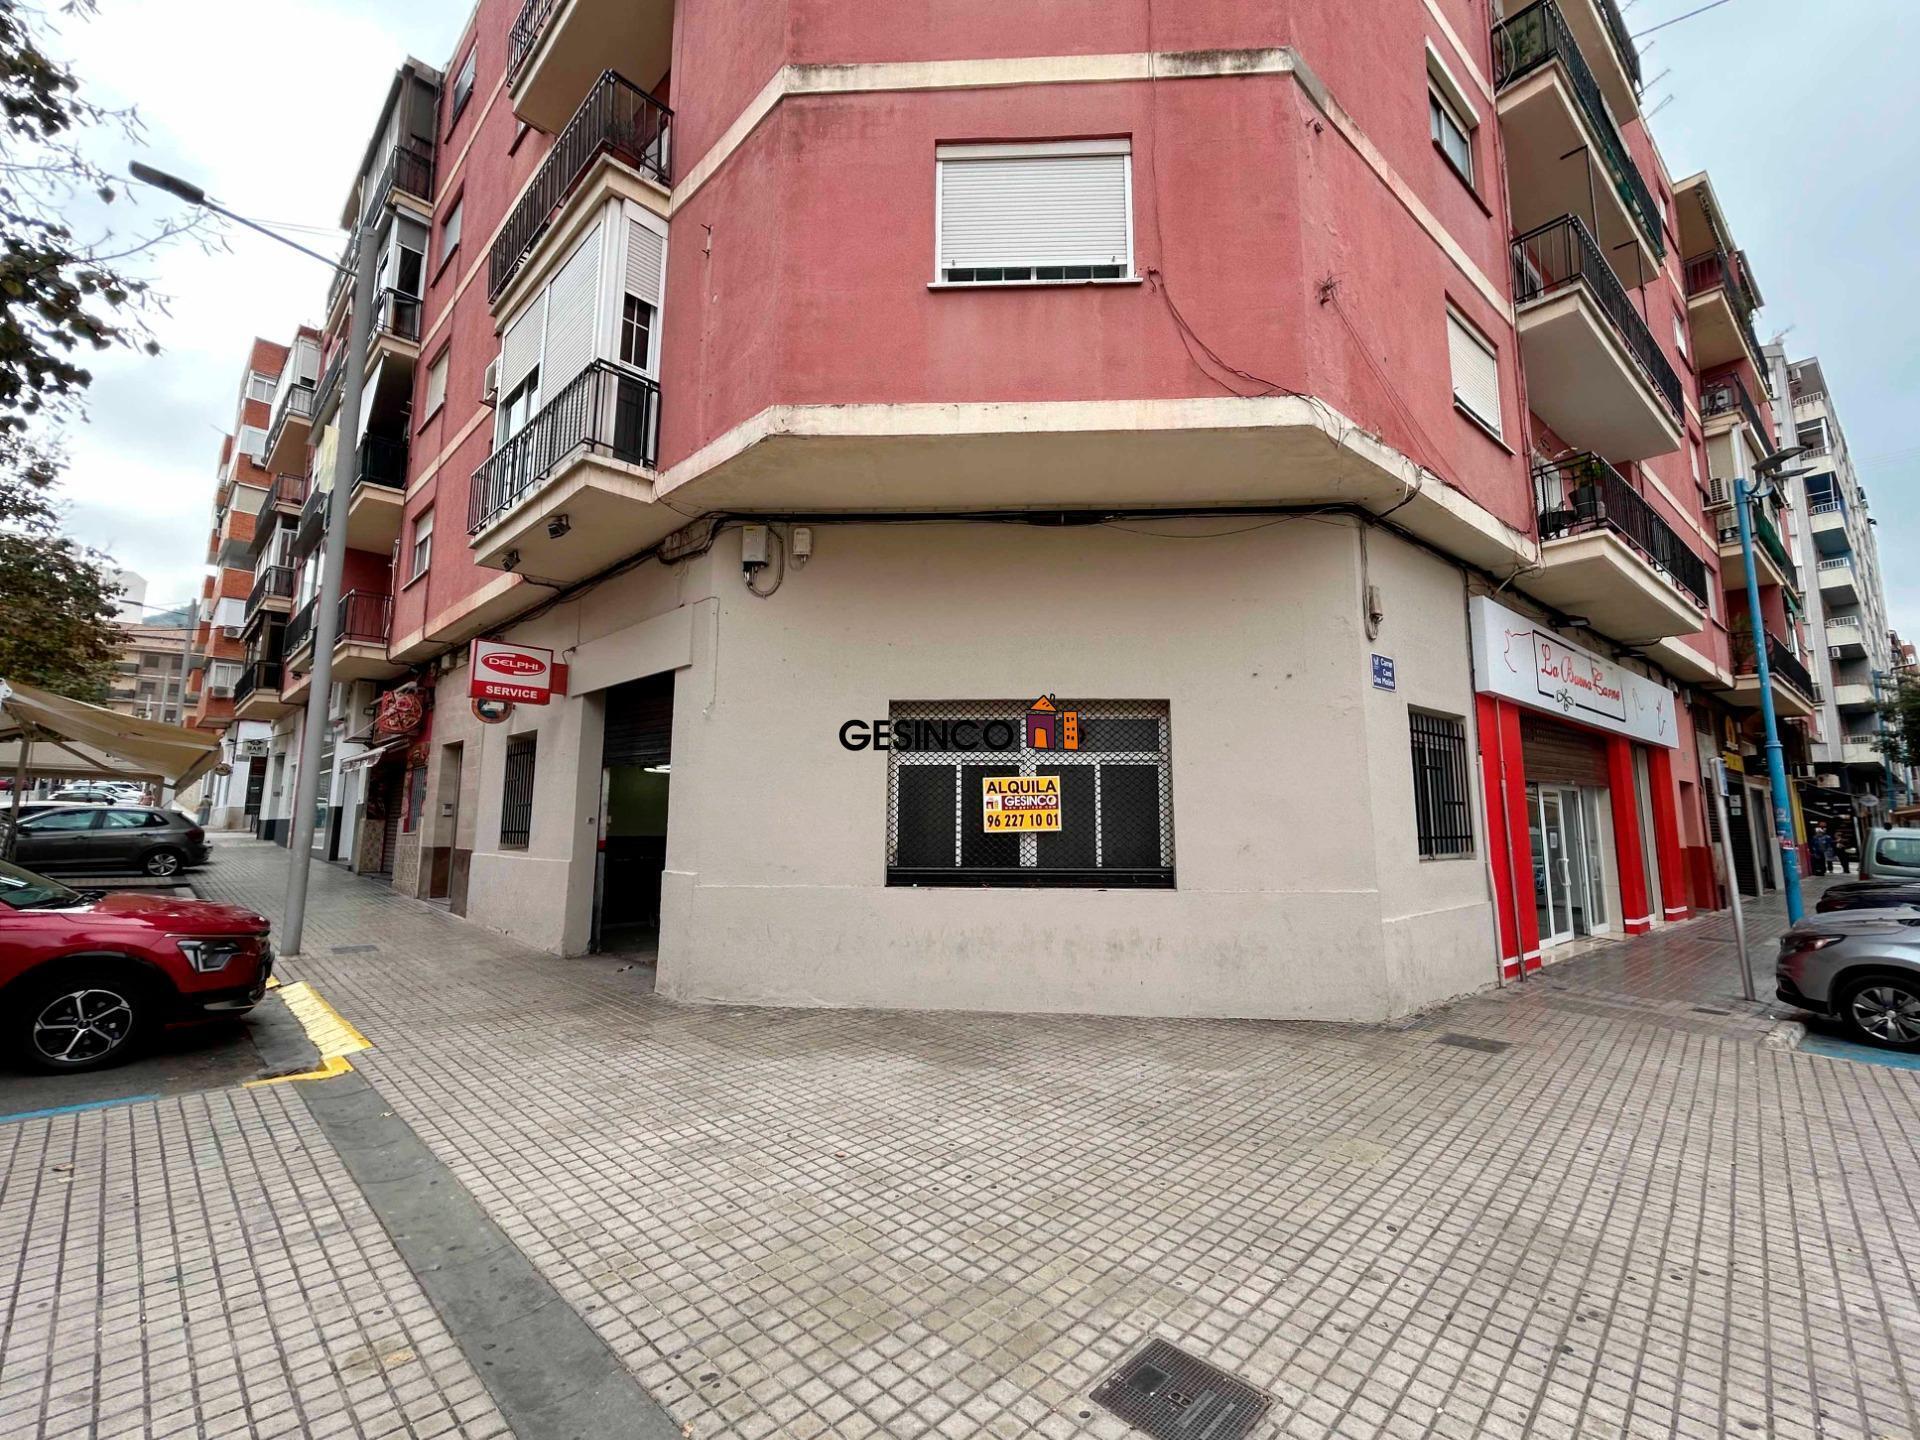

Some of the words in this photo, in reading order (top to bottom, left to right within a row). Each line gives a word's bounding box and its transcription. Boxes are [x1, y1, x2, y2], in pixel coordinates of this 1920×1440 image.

[488, 657, 539, 671] DELPHI
[1541, 643, 1559, 678] La
[486, 685, 538, 699] SERVICE
[986, 780, 1057, 795] ALQUILA
[1004, 795, 1057, 807] GESINCO
[987, 814, 1001, 827] 96
[1004, 814, 1025, 827] 227
[1029, 813, 1043, 827] 10
[1046, 813, 1059, 827] 01
